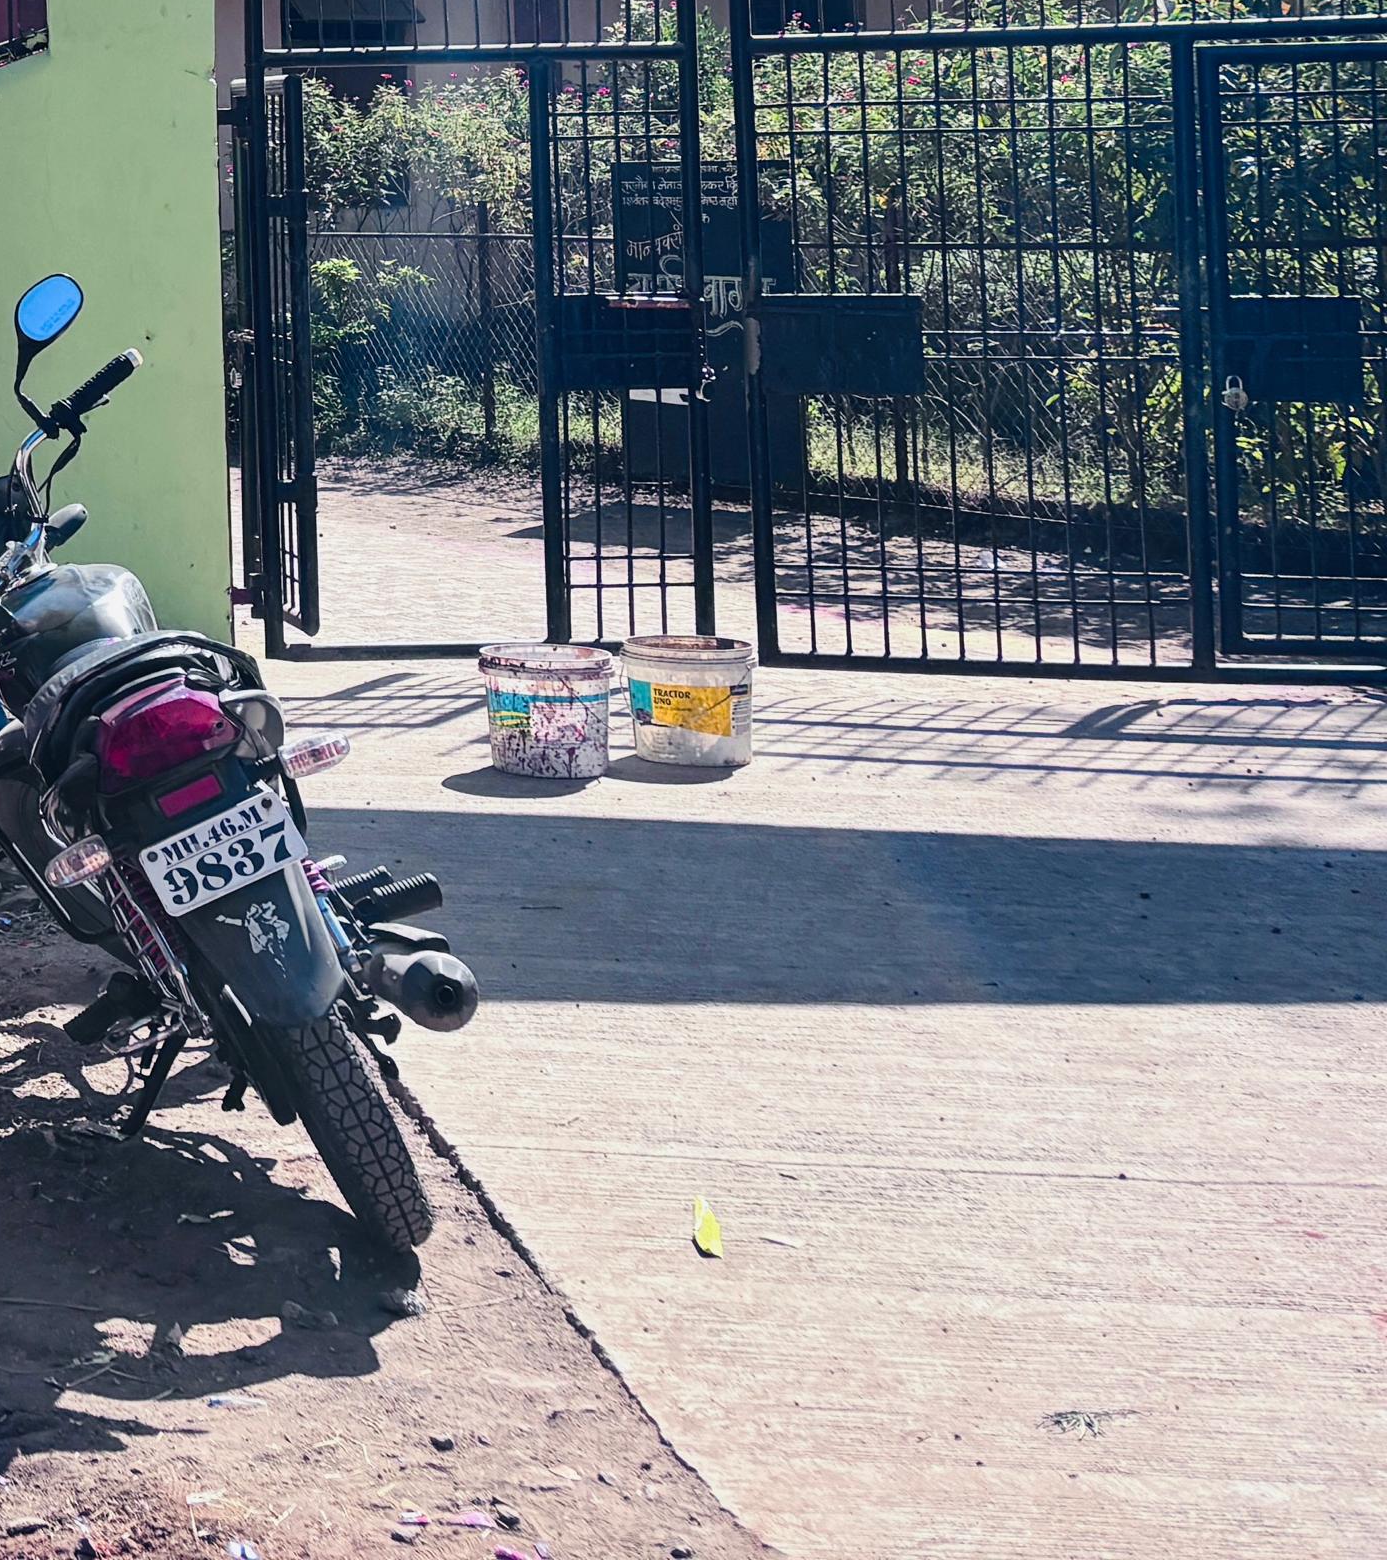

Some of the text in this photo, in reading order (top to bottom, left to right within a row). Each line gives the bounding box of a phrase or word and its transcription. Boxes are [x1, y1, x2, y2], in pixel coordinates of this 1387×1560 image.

[653, 688, 691, 699] TRACTOR
[653, 697, 671, 706] UNO
[163, 819, 292, 905] 9837
